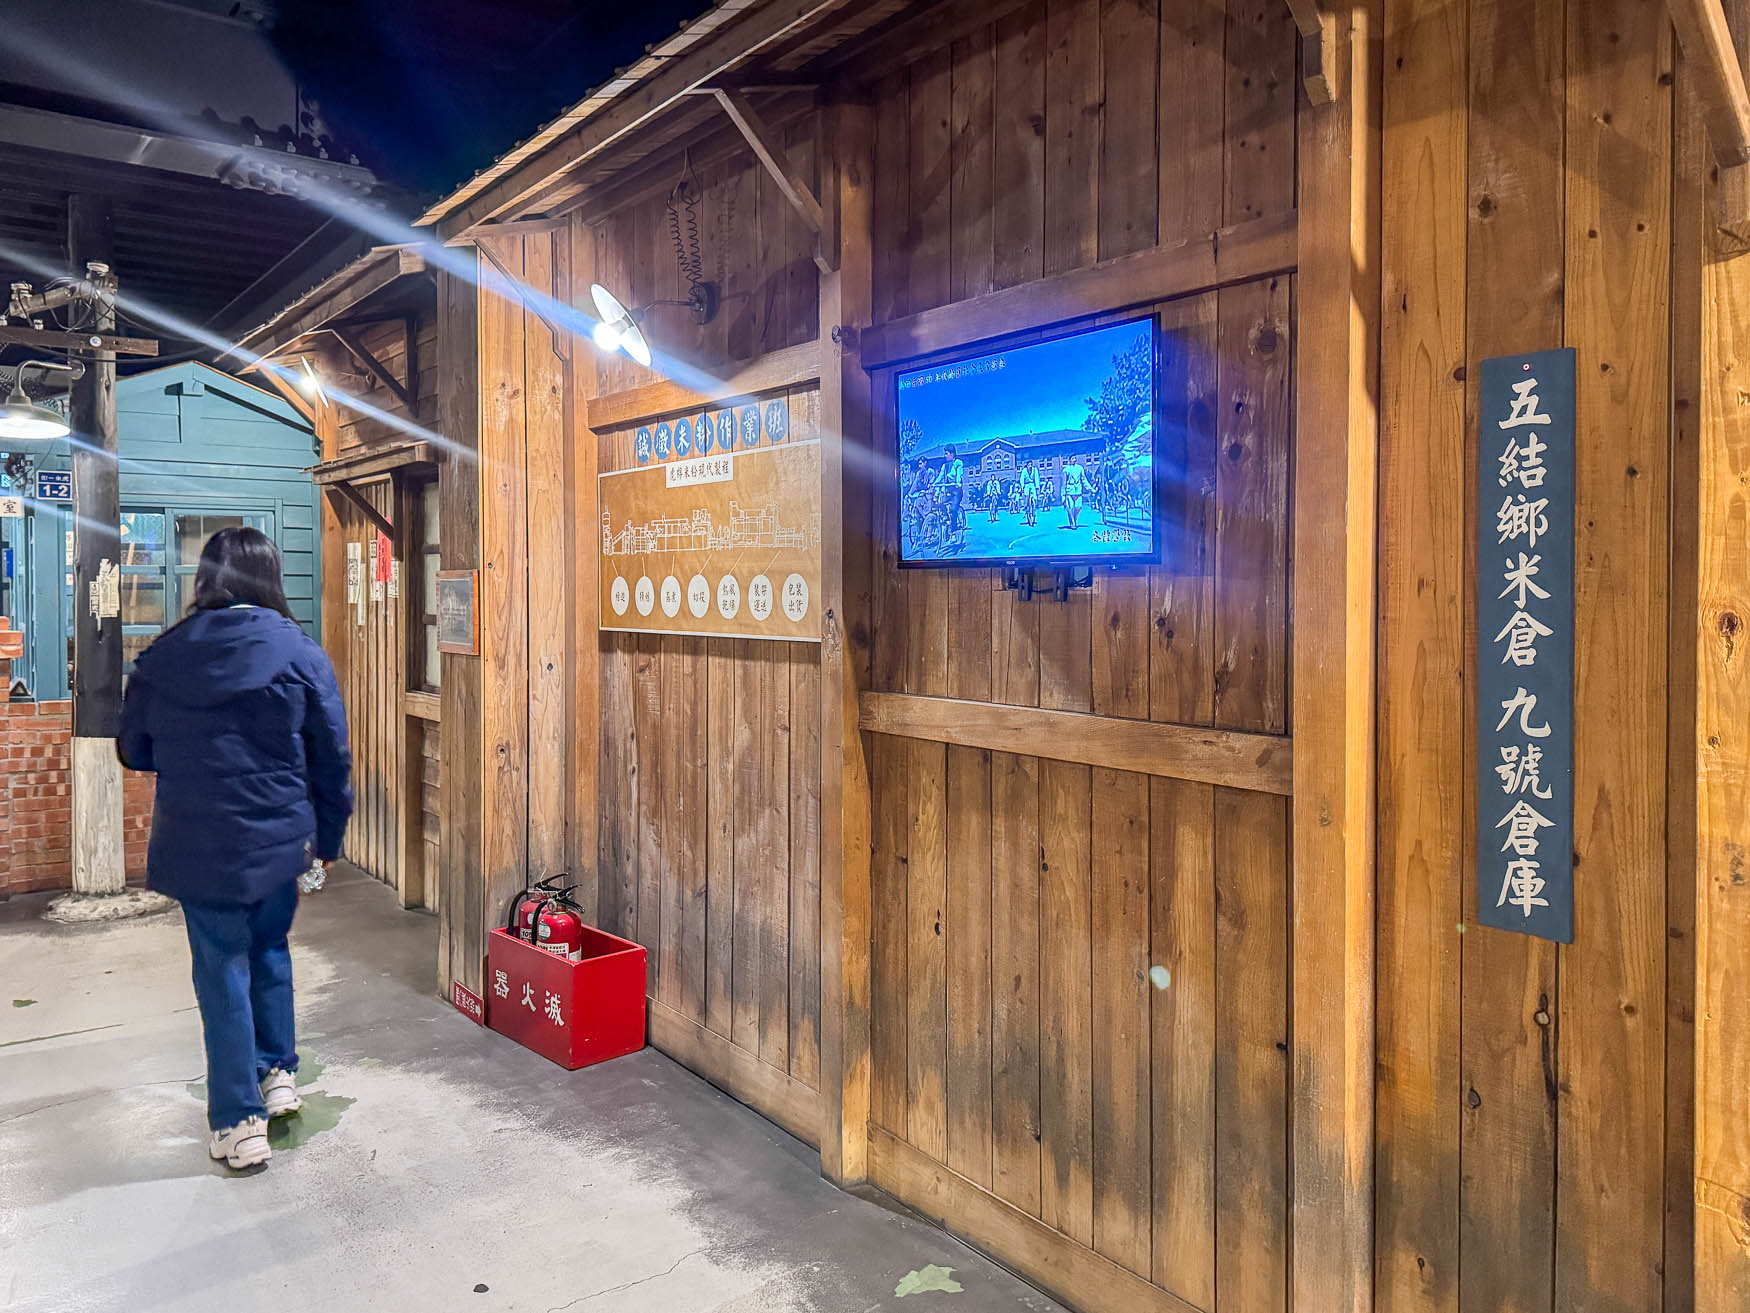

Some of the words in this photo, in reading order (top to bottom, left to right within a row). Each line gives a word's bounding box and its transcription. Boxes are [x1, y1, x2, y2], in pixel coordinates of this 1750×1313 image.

[42, 484, 68, 497] 1-2
[1493, 377, 1555, 667] 五結鄉米倉
[1494, 686, 1557, 919] 九號倉庫
